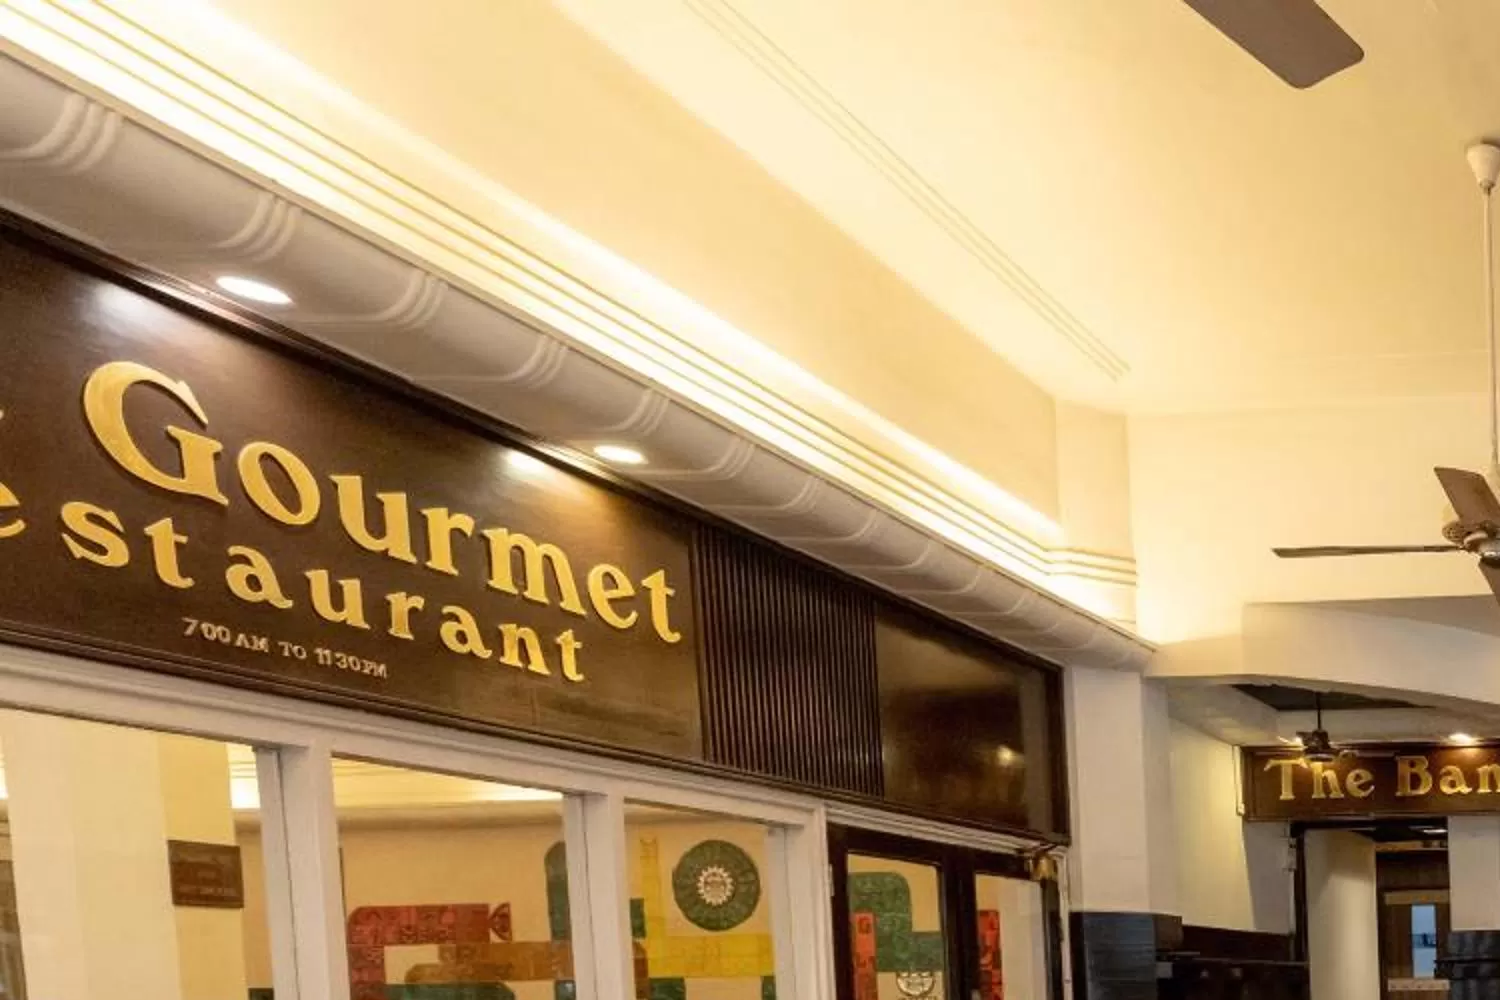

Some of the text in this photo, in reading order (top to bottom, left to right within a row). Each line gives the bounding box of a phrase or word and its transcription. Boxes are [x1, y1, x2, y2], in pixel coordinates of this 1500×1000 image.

[82, 360, 683, 645] Gourmet
[278, 641, 307, 660] TO
[1263, 758, 1376, 800] The
